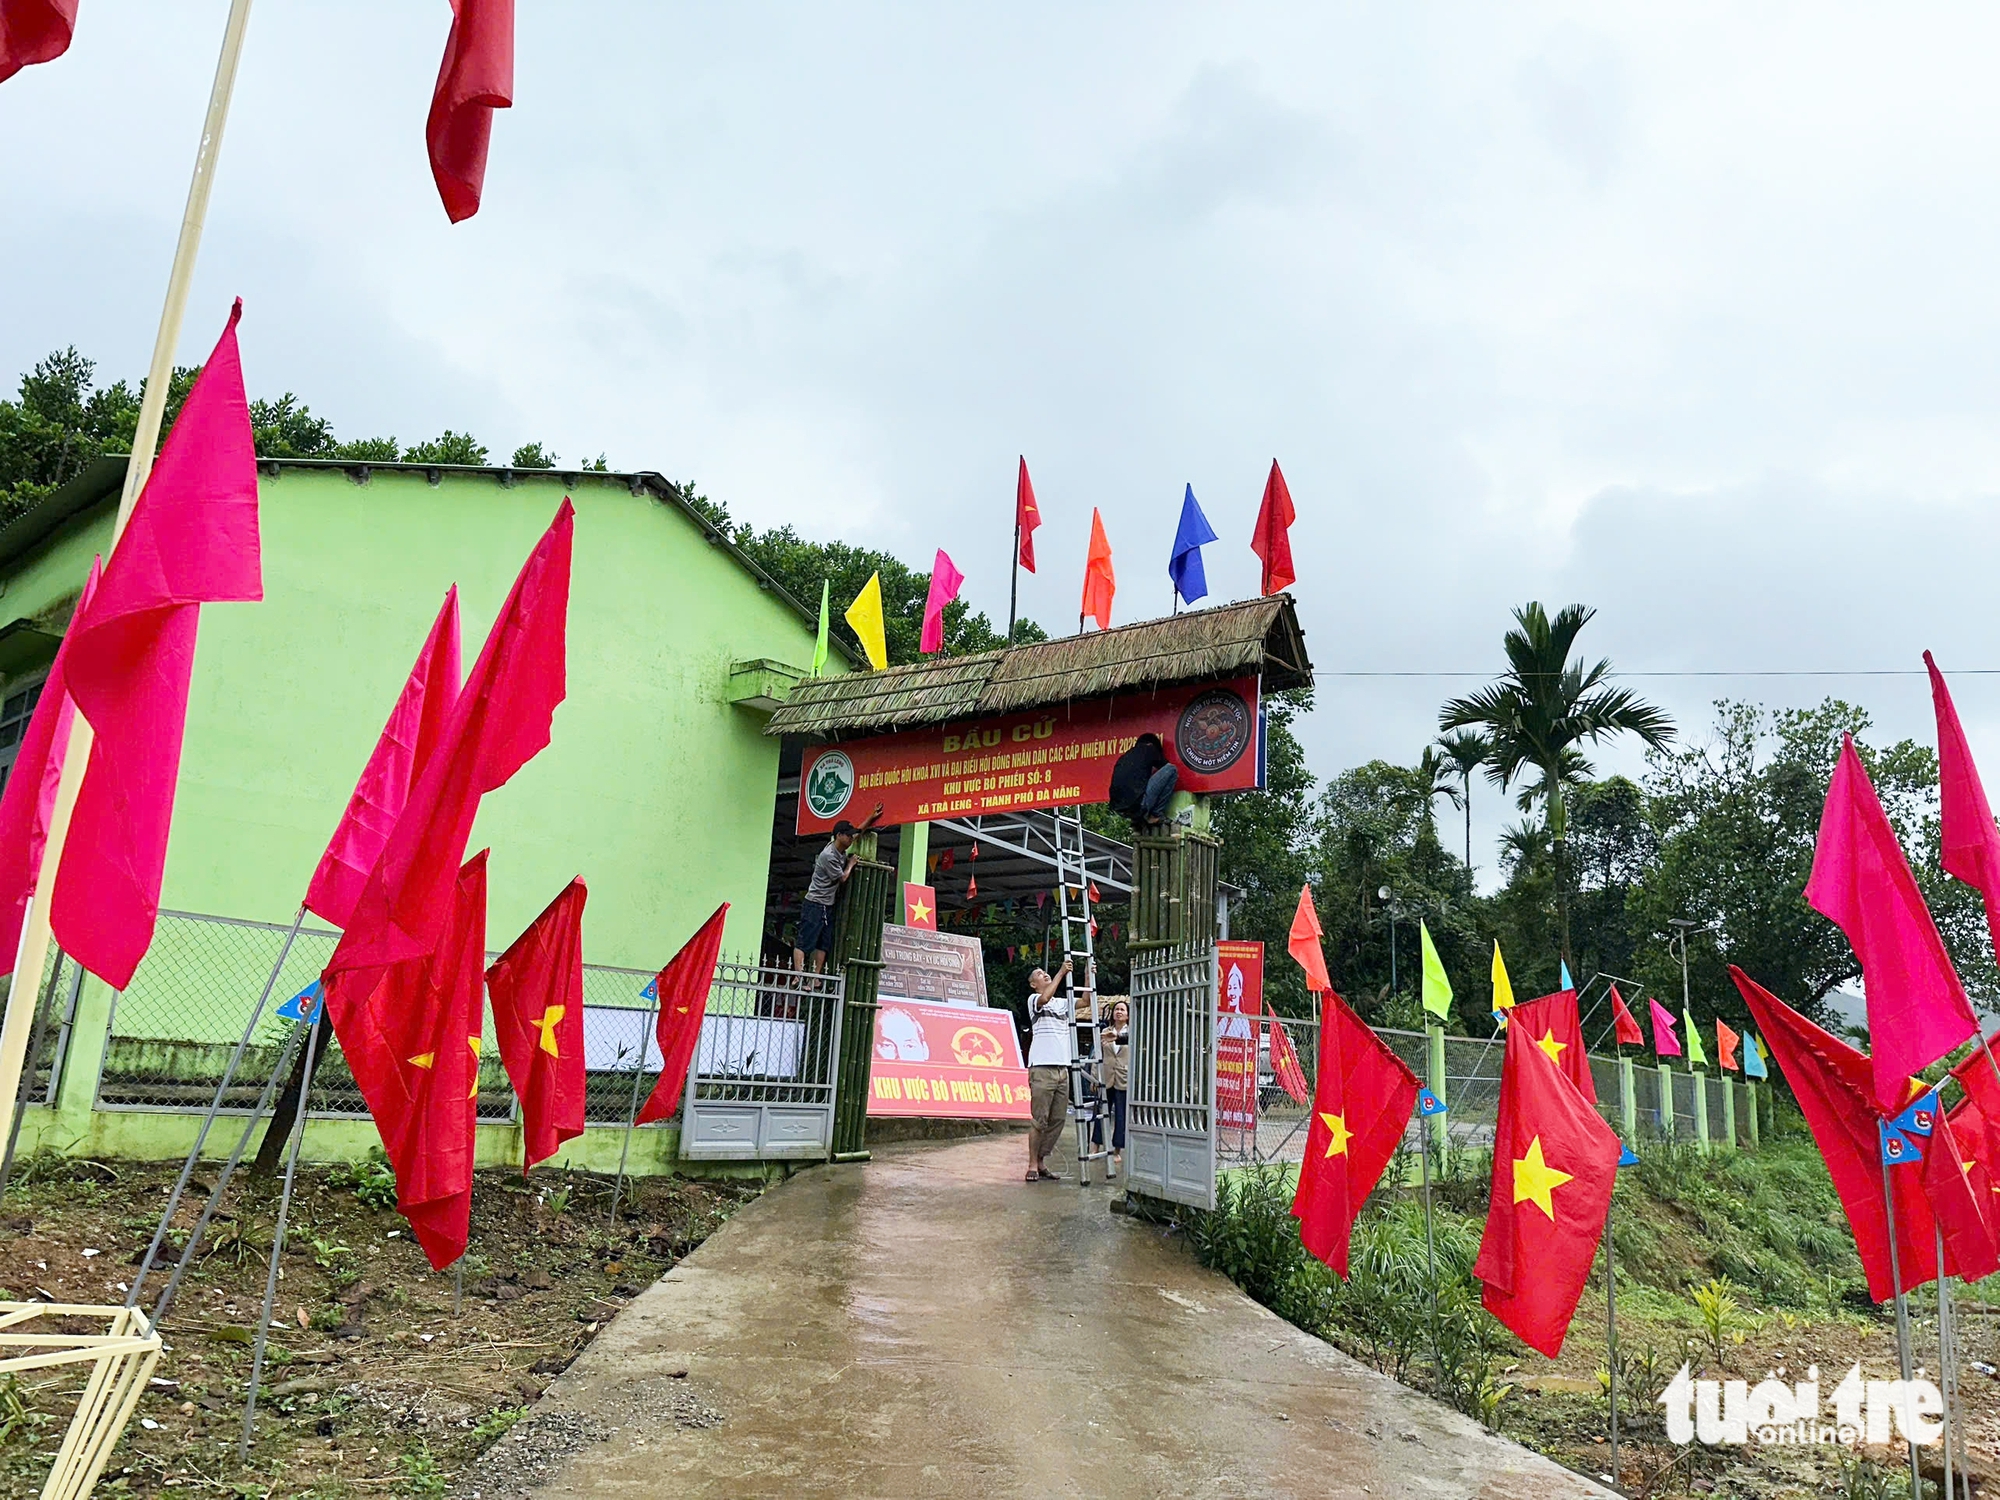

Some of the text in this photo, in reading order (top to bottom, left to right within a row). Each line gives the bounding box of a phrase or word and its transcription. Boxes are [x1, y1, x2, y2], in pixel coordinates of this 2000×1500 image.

[943, 715, 1057, 753] BẦU CỬ
[859, 774, 869, 791] ĐẠI
[870, 767, 884, 788] BIỂU
[884, 765, 900, 786] QUỐC
[901, 766, 912, 785] HỘI
[912, 763, 929, 781] KHOÁ
[930, 764, 941, 779] XVI
[942, 760, 950, 777] VÀ
[951, 761, 962, 778] ĐẠI
[963, 754, 978, 774] BIỂU
[979, 754, 990, 775] HỘI
[991, 751, 1011, 770] ĐỒNG
[1012, 748, 1031, 768] NHÂN
[1032, 747, 1047, 765] DÂN
[1049, 744, 1063, 762] CÁC
[1064, 739, 1079, 760] CẤP
[1081, 739, 1106, 760] NHIỆM
[1186, 747, 1202, 764] CHUNG
[1203, 759, 1216, 767] MỘT
[1230, 740, 1240, 752] TIN
[943, 767, 1051, 795] KHU VỰC BỎ PHIẾU SỐ: 8
[918, 802, 929, 815] XÃ
[931, 802, 948, 813] TRÀ
[950, 799, 972, 811] LENG
[981, 795, 1011, 808] THÀNH
[1013, 789, 1033, 804] PHỐ
[1036, 788, 1049, 801] ĐÀ
[1053, 785, 1080, 799] NẴNG
[873, 1075, 1013, 1104] KHU VỰC BỎ PHIẾU SỐ 8
